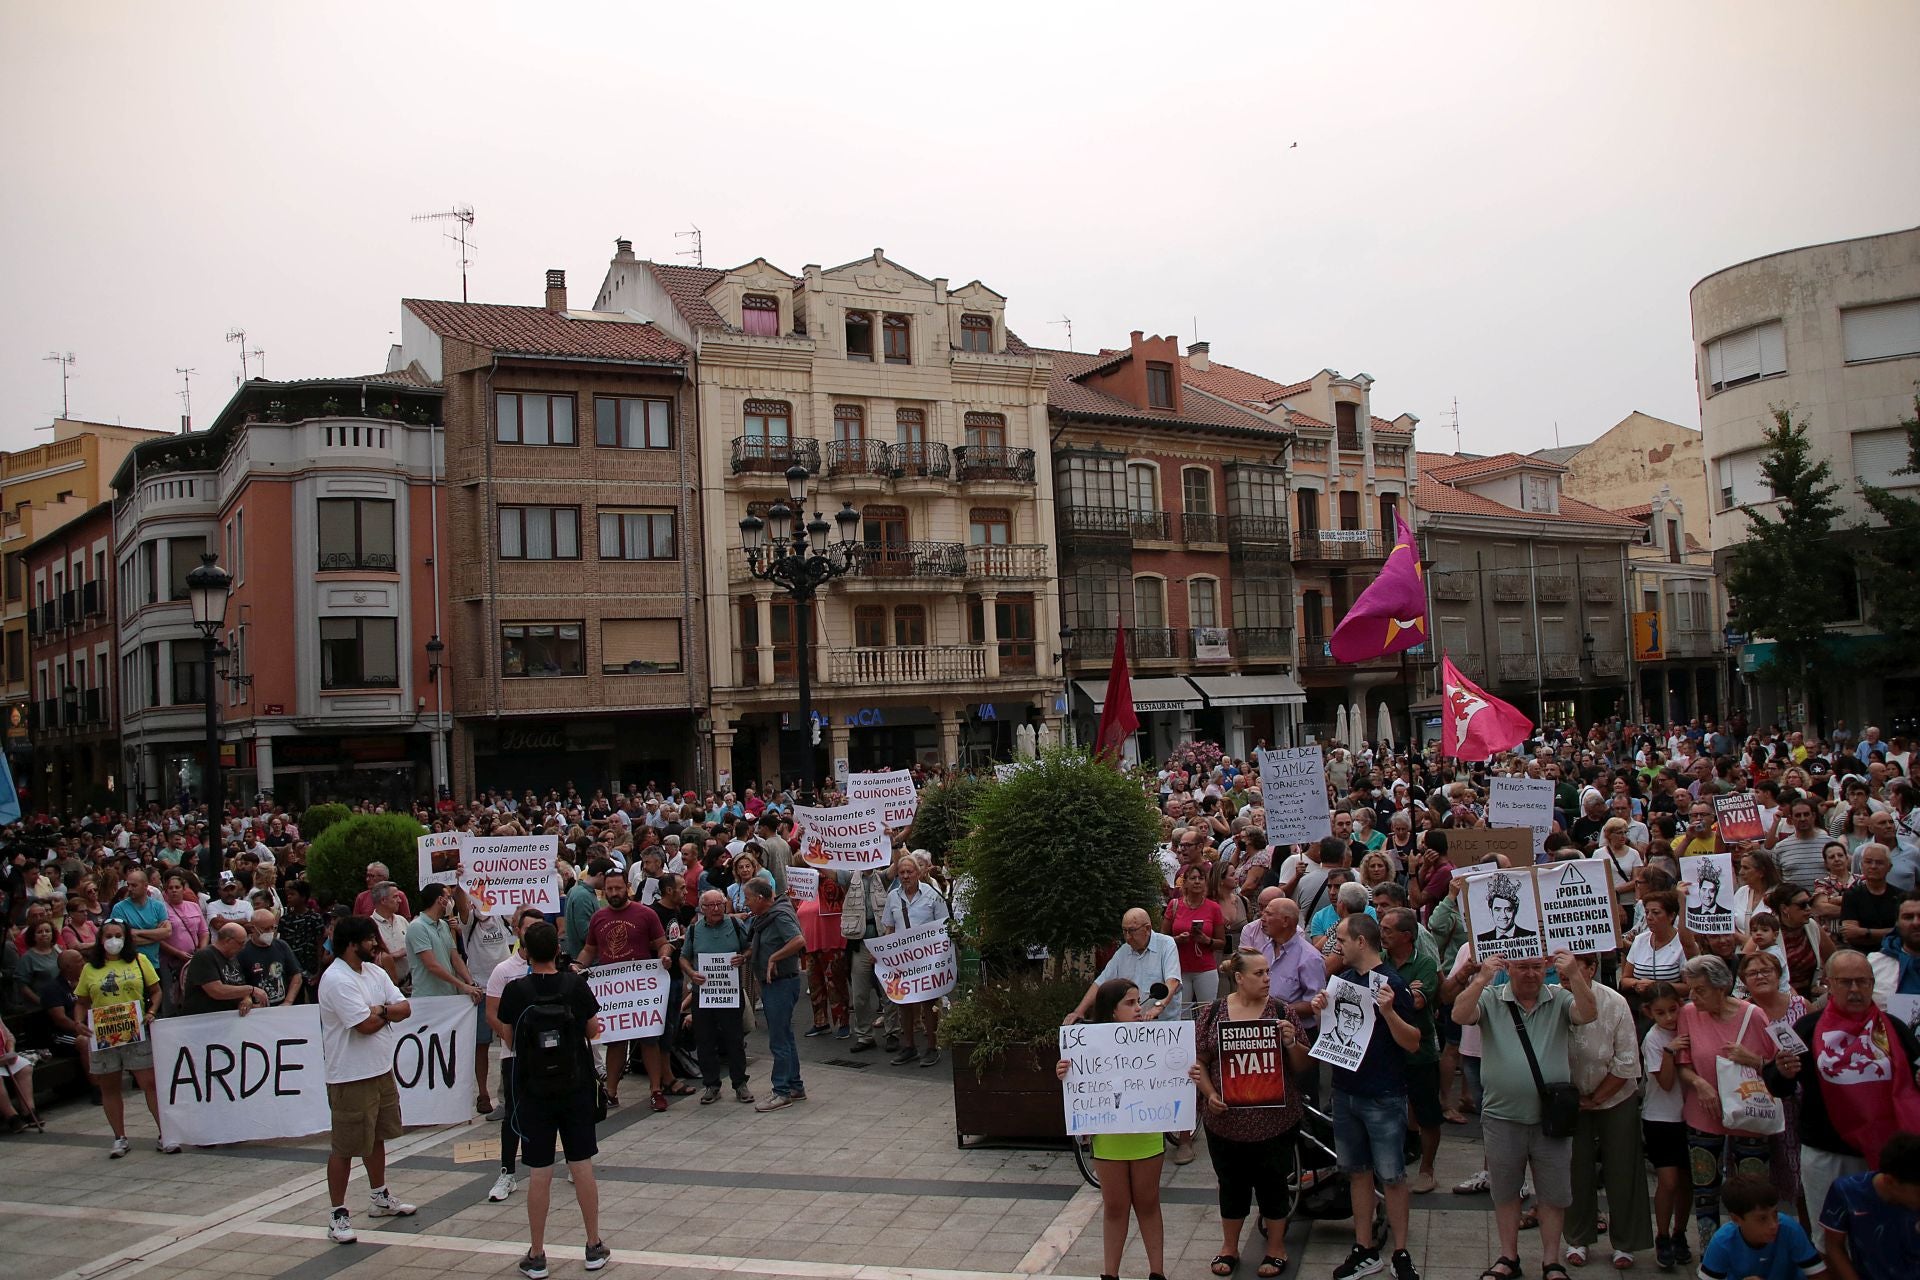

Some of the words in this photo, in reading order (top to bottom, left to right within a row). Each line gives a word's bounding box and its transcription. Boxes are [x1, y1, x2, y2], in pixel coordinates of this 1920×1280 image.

[1136, 701, 1184, 710] RESTAURANTE
[1264, 750, 1294, 762] VALLE
[1298, 746, 1318, 758] DEL
[1272, 761, 1317, 778] JAMUZ
[864, 777, 901, 786] solamente
[1266, 778, 1314, 790] TORNEROS
[1496, 782, 1524, 792] MENOS
[854, 786, 912, 800] QUIÑONES
[1512, 802, 1547, 810] BOMBEROS
[1716, 795, 1742, 806] ESTADO
[1717, 800, 1755, 812] EMERGENCIA
[814, 810, 864, 822] solamente
[866, 808, 876, 816] es
[1724, 808, 1756, 826] ¡YA!!
[810, 822, 876, 837] QUIÑONES
[424, 836, 458, 848] GRACIA
[873, 836, 881, 844] el
[1450, 840, 1478, 850] ARDE
[1486, 840, 1518, 849] TODO
[488, 844, 537, 852] solamente
[473, 858, 547, 872] QUIÑONES
[478, 876, 524, 888] problema
[526, 876, 538, 884] es
[540, 875, 549, 883] el
[1556, 886, 1578, 899] ¡POR
[1581, 884, 1592, 895] LA
[1544, 898, 1596, 910] DECLARACIÓN
[1599, 896, 1608, 904] DE
[1548, 909, 1608, 924] EMERGENCIA
[1548, 926, 1575, 938] NIVEL
[1578, 927, 1584, 936] 3
[1586, 923, 1611, 935] PARA
[1722, 922, 1732, 930] YA!
[887, 930, 936, 950] solamente
[1478, 938, 1538, 951] SUAREZ-QUIÑONES
[1568, 939, 1596, 951] LEÓN!
[882, 940, 949, 967] QUIÑONES
[1525, 947, 1540, 956] YA!
[590, 963, 642, 978] solamente
[935, 959, 946, 968] es
[594, 977, 658, 997] UIÑONES
[598, 1000, 633, 1012] oblema
[637, 998, 649, 1006] es
[654, 995, 662, 1004] el
[98, 1019, 136, 1036] DIMISIÓN
[597, 1010, 663, 1033] STEMA
[1062, 1027, 1087, 1049] ¡SE
[1114, 1026, 1182, 1045] QUEMAN
[1222, 1026, 1260, 1040] ESTADO
[1262, 1026, 1276, 1038] DE
[1222, 1038, 1277, 1050] EMERGENCIA
[1318, 1040, 1330, 1048] JOSE
[1343, 1048, 1360, 1060] ARRANZ
[170, 1039, 308, 1105] ARDE
[392, 1025, 456, 1090] ÓN
[1070, 1054, 1156, 1075] NUESTROS
[1230, 1052, 1276, 1078] ¡YA!!
[1313, 1048, 1347, 1065] ¡DESTITUCIÓN
[1349, 1060, 1358, 1068] YA!
[1066, 1080, 1113, 1094] PUEBLOS
[1124, 1079, 1145, 1091] POR
[1150, 1077, 1192, 1090] VUESTRA
